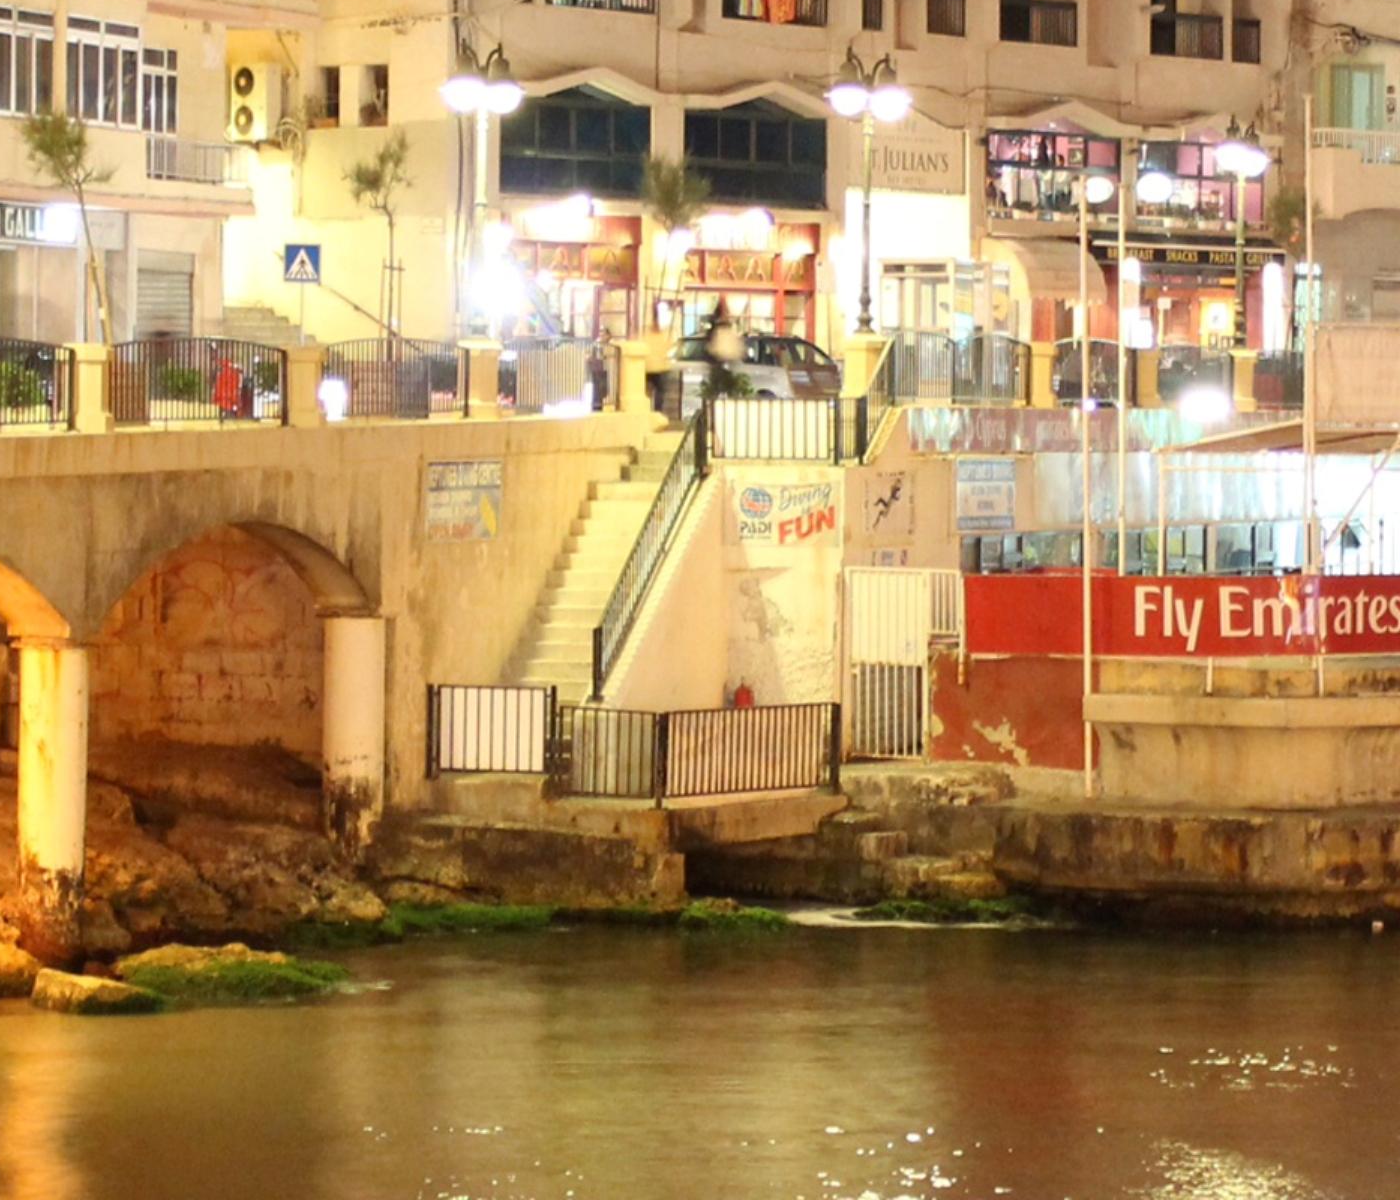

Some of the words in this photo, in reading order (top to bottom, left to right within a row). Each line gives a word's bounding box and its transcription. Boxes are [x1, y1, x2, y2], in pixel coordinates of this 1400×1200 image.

[778, 483, 833, 512] Diving
[740, 520, 772, 534] PADI
[777, 505, 836, 545] FUN
[1134, 584, 1203, 651] Fly
